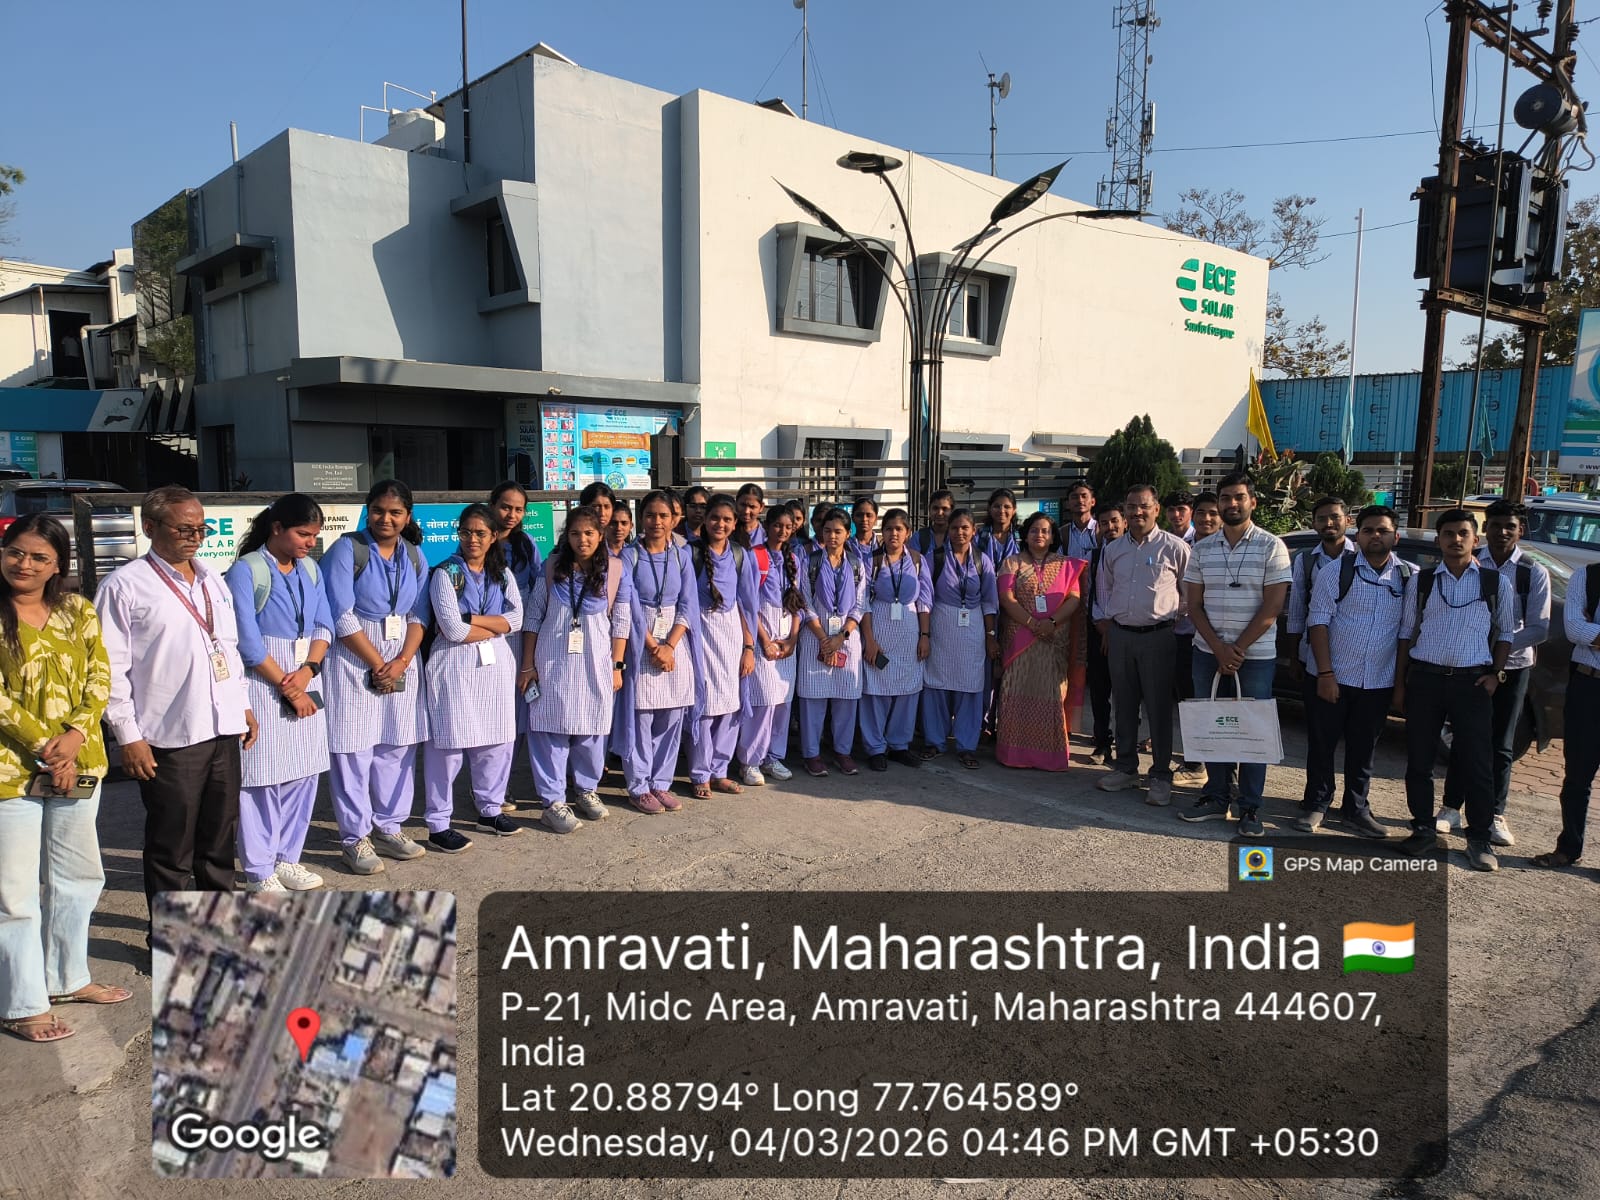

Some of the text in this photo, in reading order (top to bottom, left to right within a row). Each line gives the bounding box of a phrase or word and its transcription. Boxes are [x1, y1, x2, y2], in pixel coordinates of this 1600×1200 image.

[1202, 262, 1236, 296] ECE
[1201, 298, 1234, 319] SOLAR
[203, 518, 234, 536] CE
[327, 515, 350, 523] PANEL
